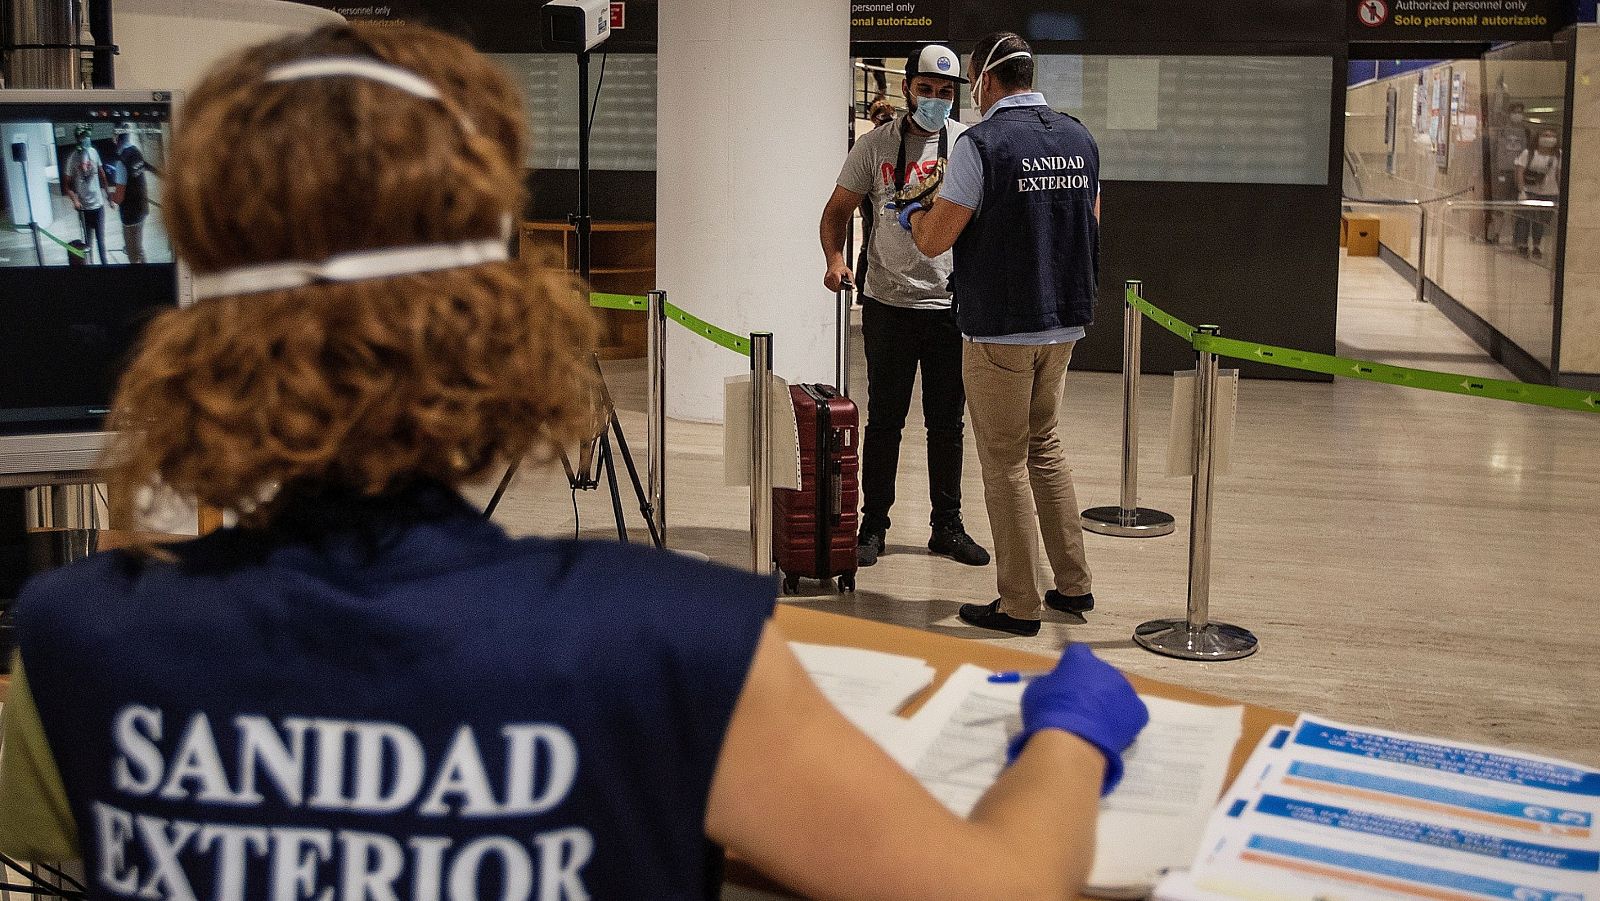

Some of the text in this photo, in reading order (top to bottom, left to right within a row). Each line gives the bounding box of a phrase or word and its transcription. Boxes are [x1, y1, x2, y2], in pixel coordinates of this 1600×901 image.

[374, 6, 391, 16] only
[852, 3, 915, 13] personnel only
[1395, 0, 1527, 12] Authorized personnel only
[850, 16, 932, 26] onal autorizado
[1394, 15, 1547, 27] Solo personal autorizado
[1022, 155, 1085, 172] SANIDAD
[881, 160, 939, 185] NAS
[1017, 175, 1089, 193] EXTERIOR
[112, 704, 580, 817] SANIDAD
[93, 801, 596, 901] EXTERIOR
